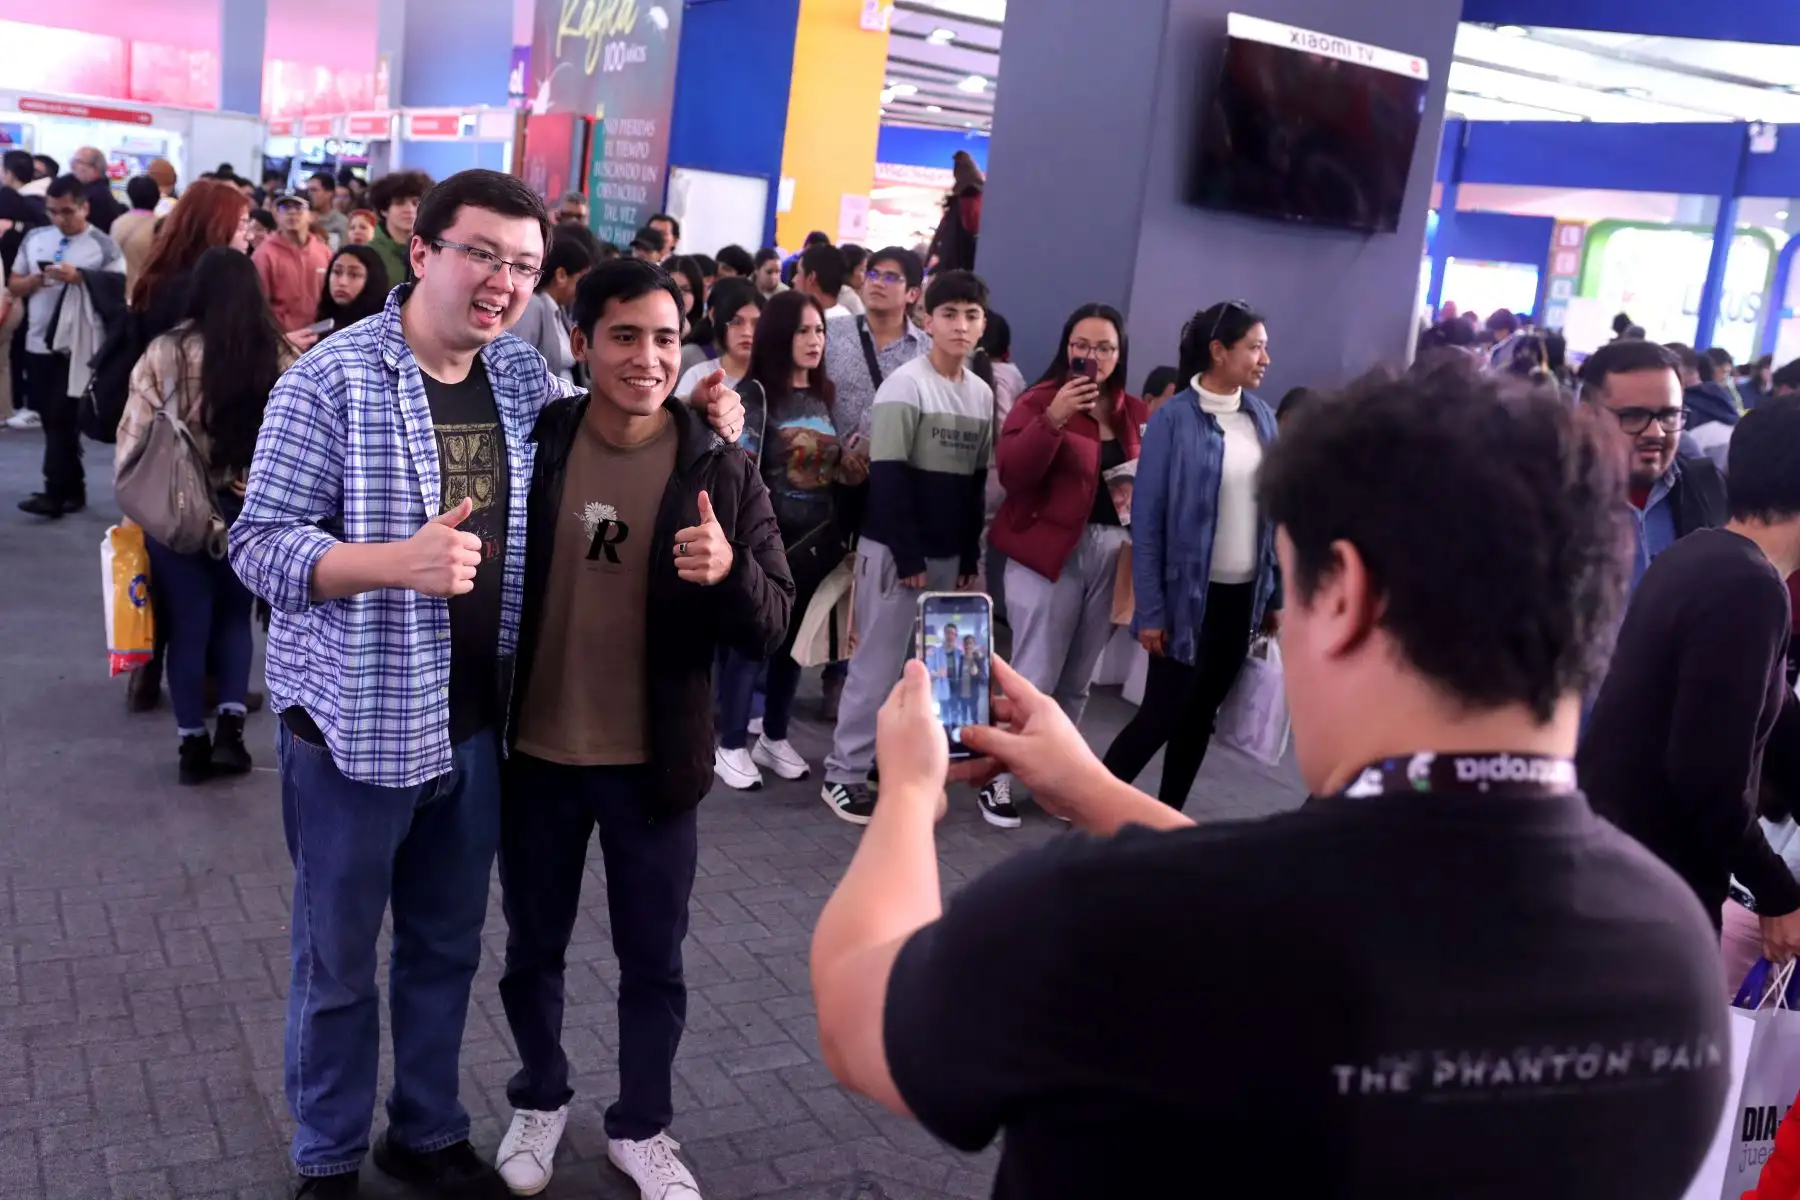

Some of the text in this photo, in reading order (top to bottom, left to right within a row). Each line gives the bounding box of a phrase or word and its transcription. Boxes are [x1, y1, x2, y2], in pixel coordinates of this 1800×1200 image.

[603, 40, 626, 72] 100
[1357, 46, 1374, 61] TV
[585, 519, 629, 563] R
